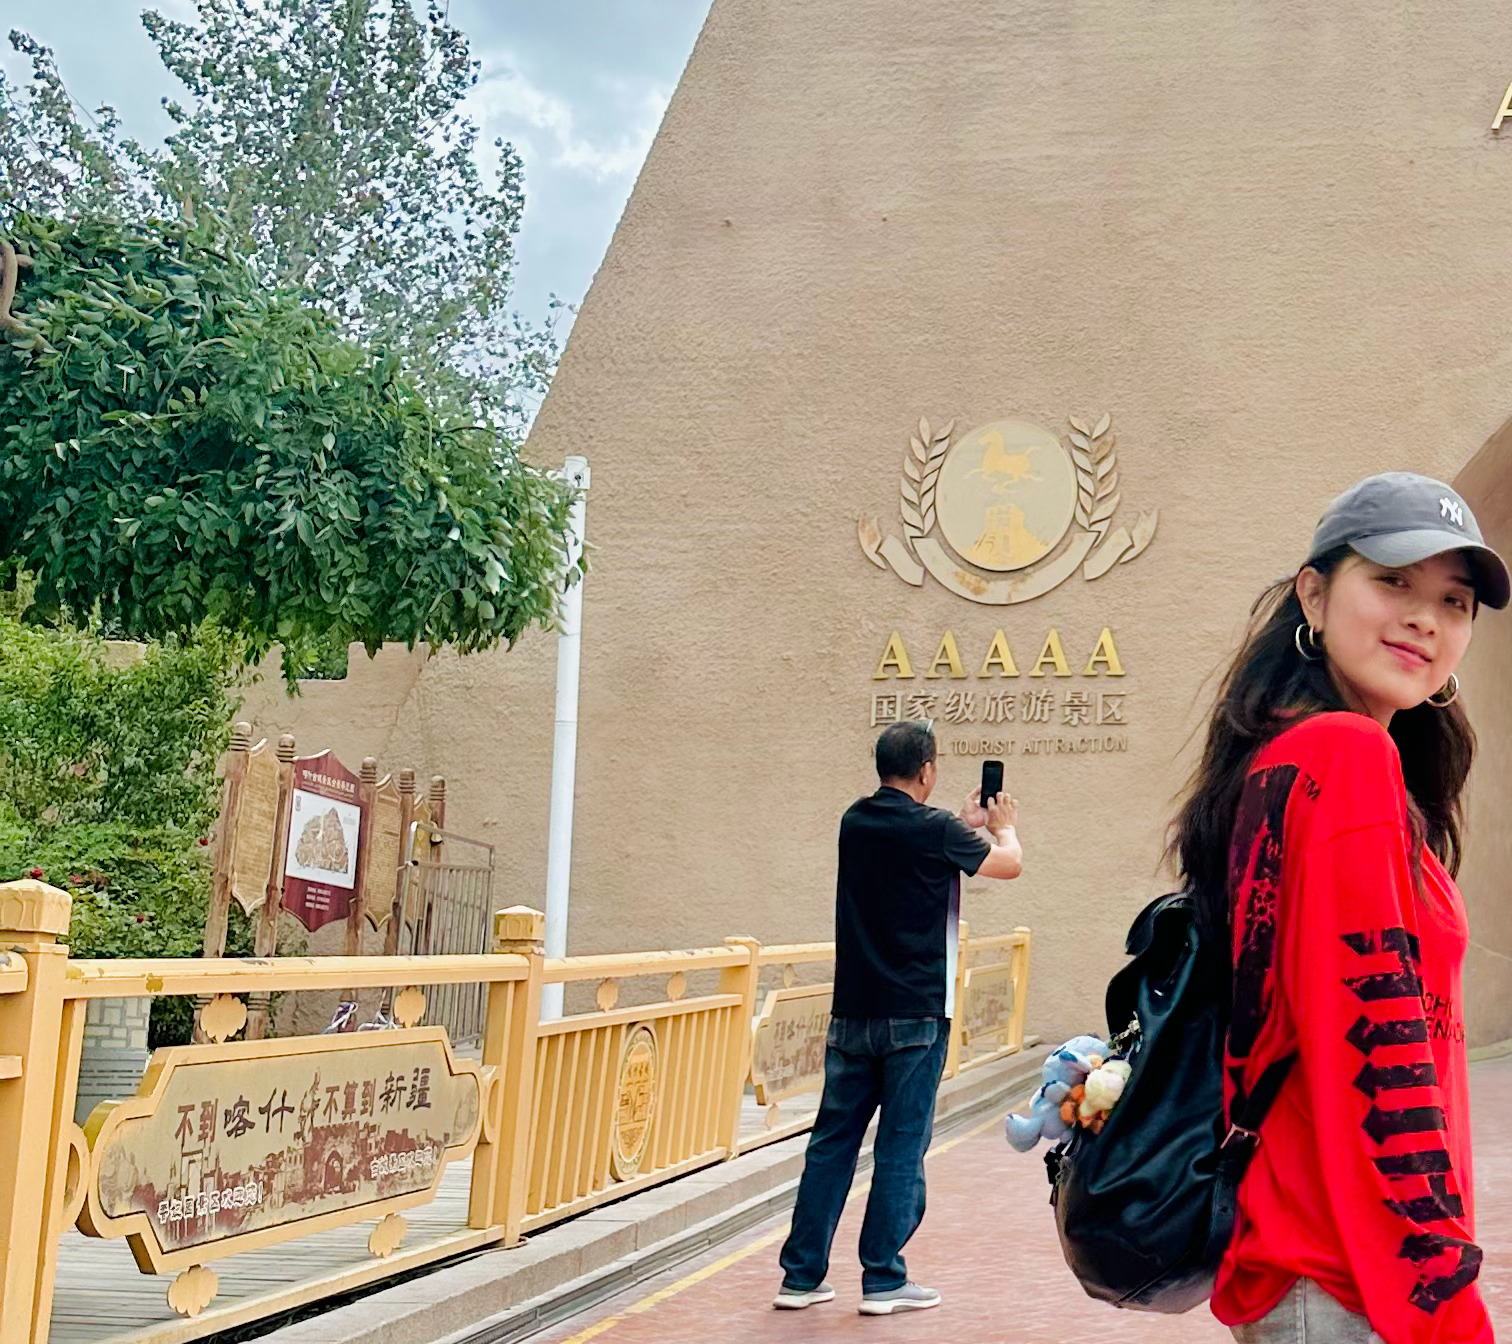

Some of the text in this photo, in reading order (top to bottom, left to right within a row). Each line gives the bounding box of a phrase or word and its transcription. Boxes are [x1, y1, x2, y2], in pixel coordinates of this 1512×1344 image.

[872, 627, 1126, 680] AAAAA
[869, 688, 1129, 728] 国家级旅游景区
[953, 739, 1015, 756] TOURIST
[1022, 736, 1128, 755] ATTRACTION
[174, 1067, 432, 1146] 不到喀什 不算到新疆
